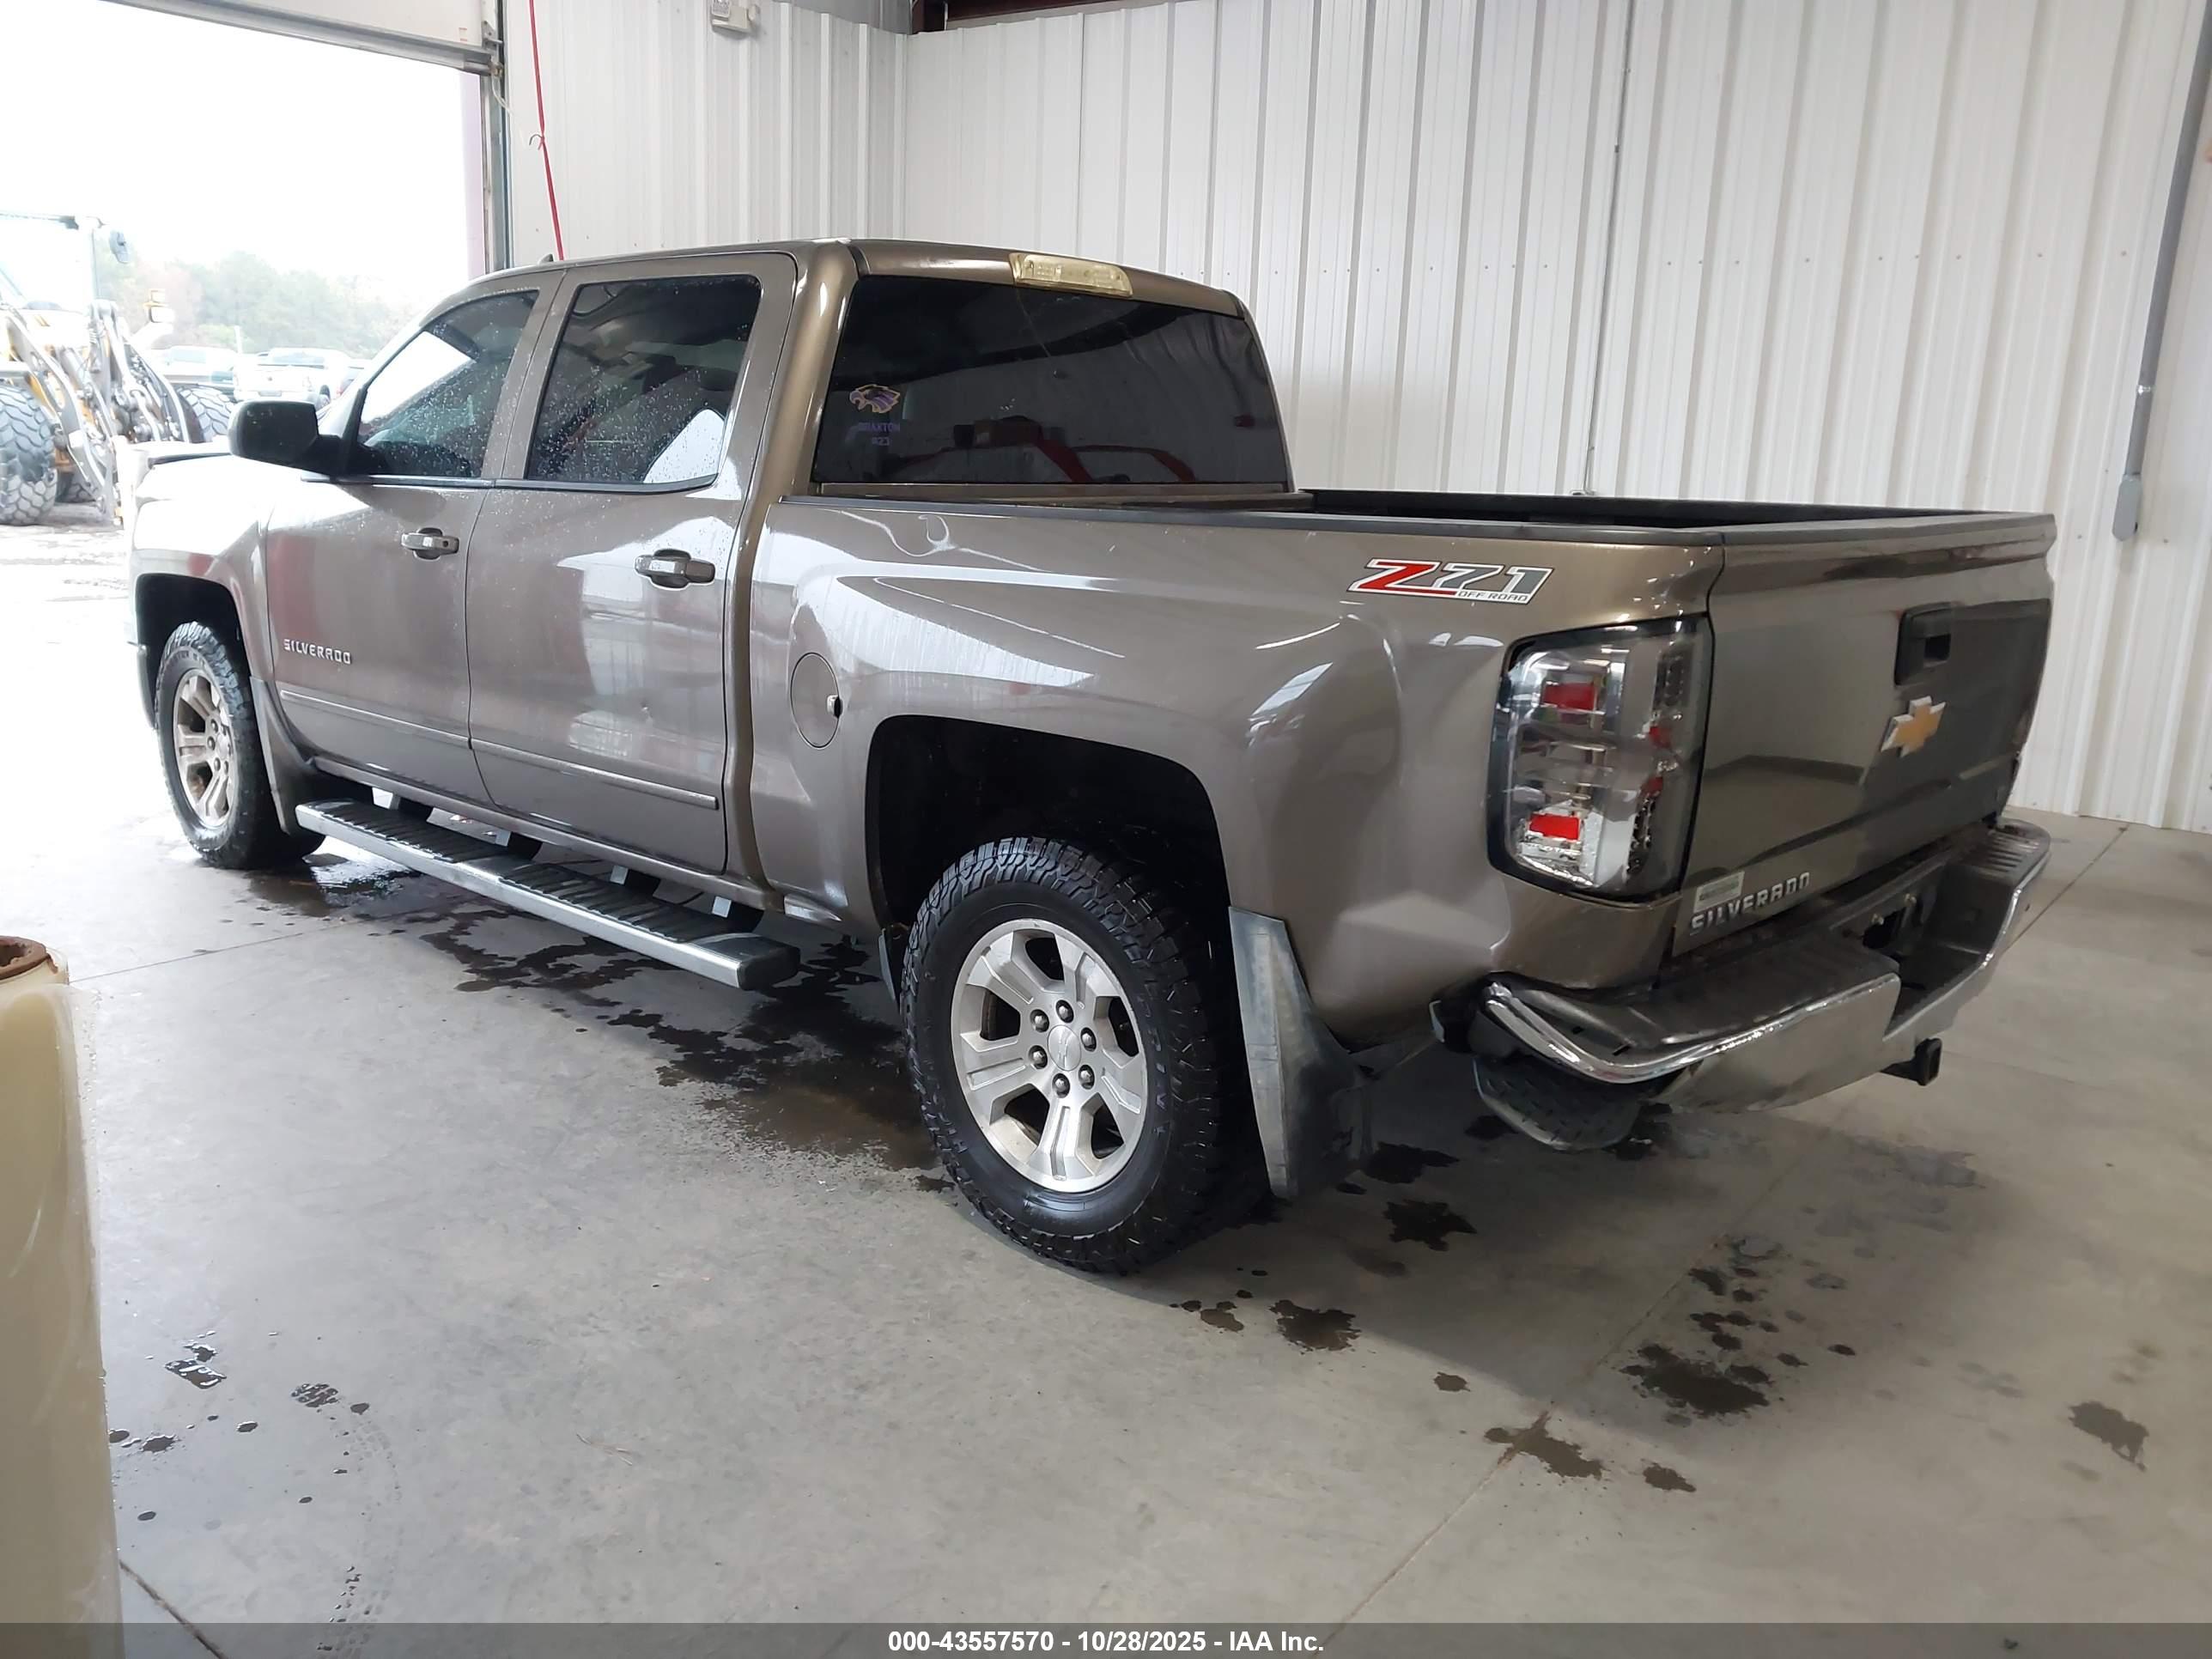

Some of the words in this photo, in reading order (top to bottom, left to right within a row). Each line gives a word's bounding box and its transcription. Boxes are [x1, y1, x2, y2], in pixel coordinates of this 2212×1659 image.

[1346, 557, 1554, 599] Z71
[1457, 590, 1486, 599] OFF
[1487, 592, 1528, 602] ROAD
[283, 638, 351, 665] SILVERADO
[1689, 872, 1811, 936] SILVERADO
